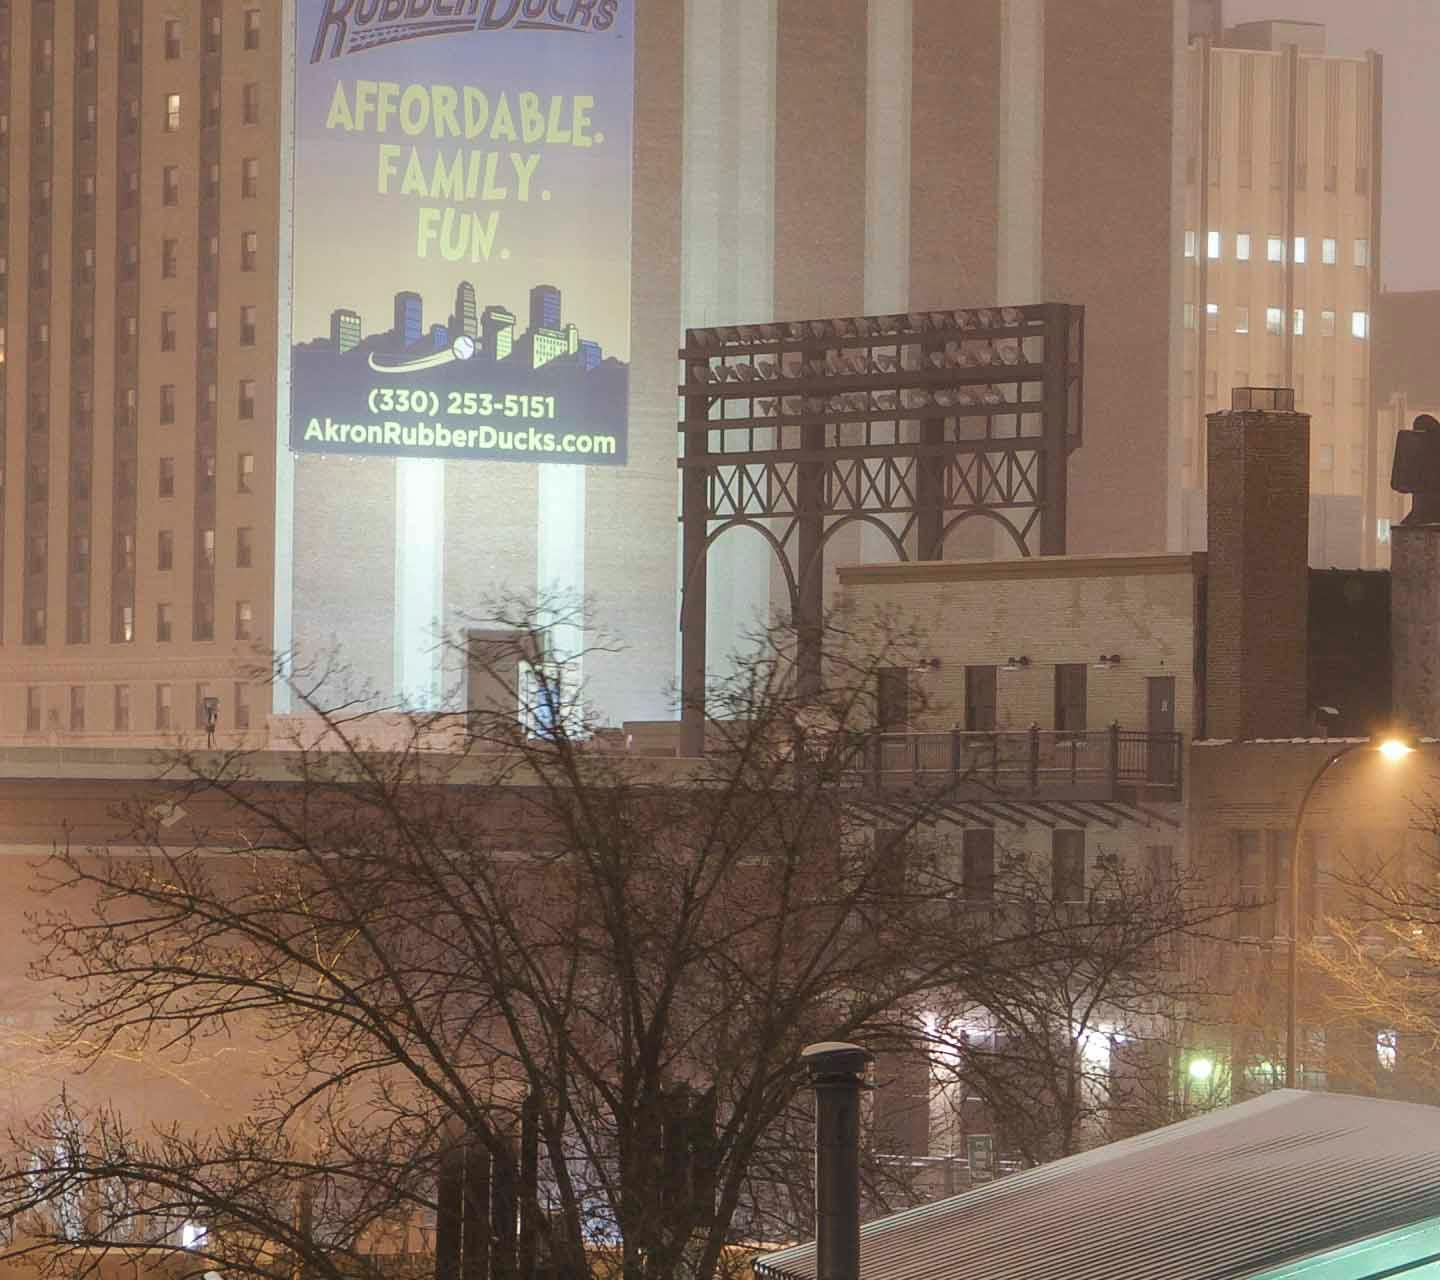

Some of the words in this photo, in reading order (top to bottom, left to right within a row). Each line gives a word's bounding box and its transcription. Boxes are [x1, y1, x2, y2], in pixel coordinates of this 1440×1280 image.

[326, 79, 604, 147] AFFORDABLE.
[378, 144, 551, 201] FAMILY.
[417, 208, 511, 263] FUN.
[368, 388, 440, 416] (330)
[447, 392, 556, 419] 253-5151
[303, 417, 616, 454] AkronRubberDucks.com
